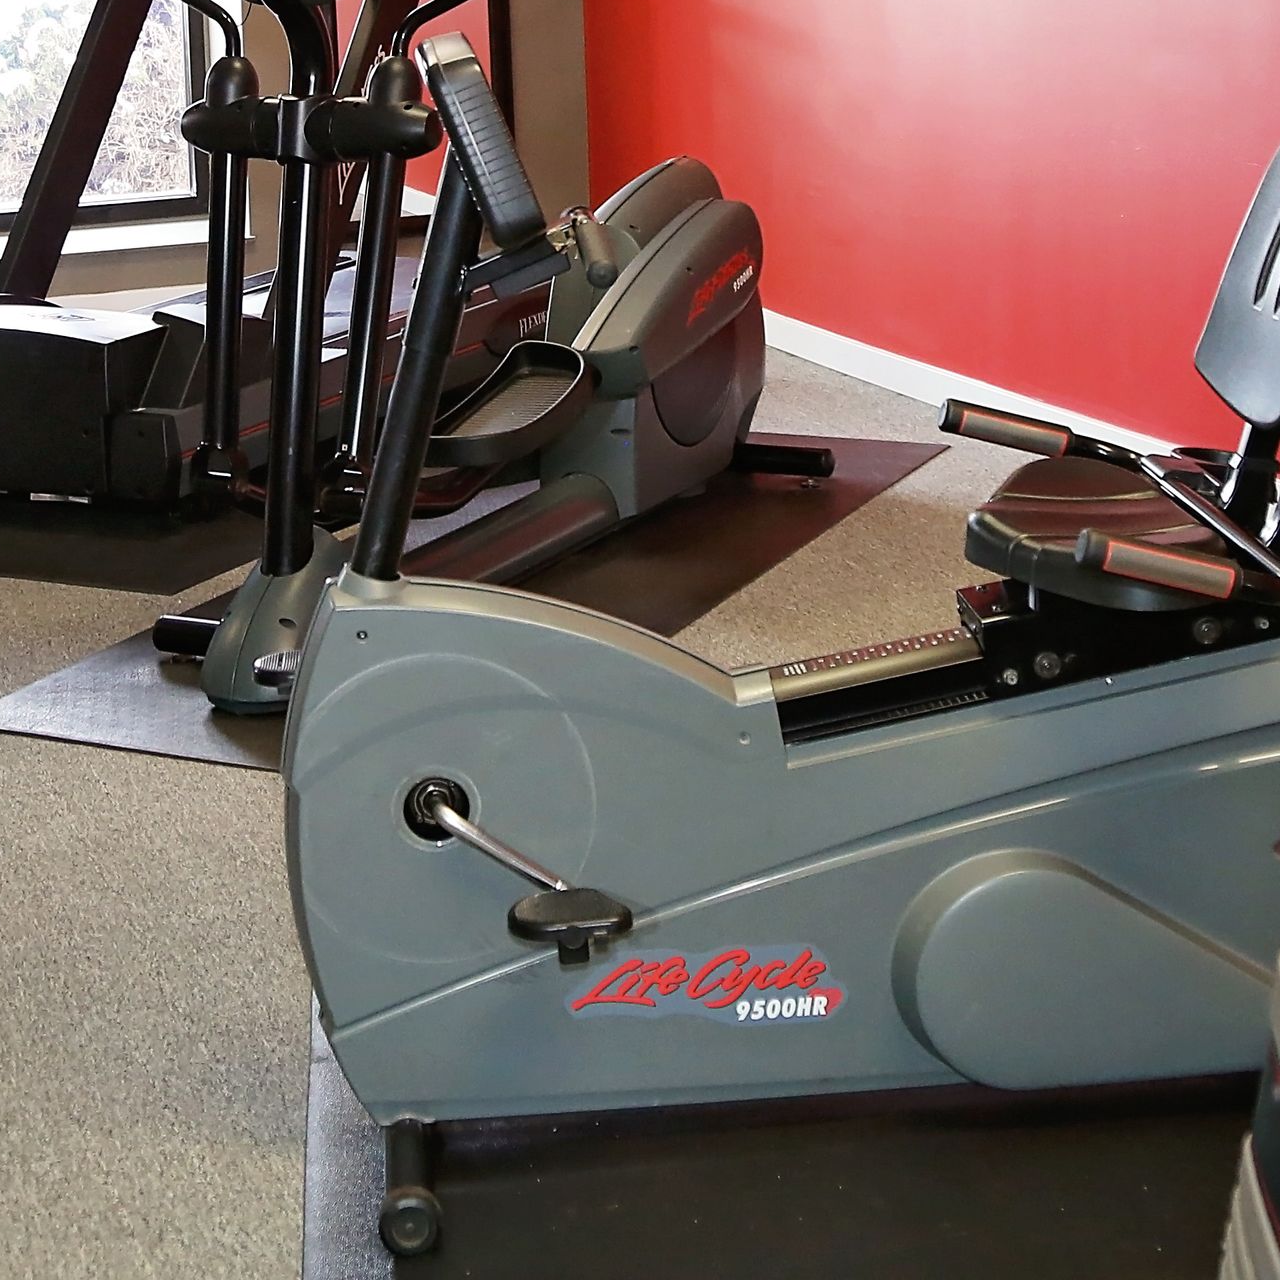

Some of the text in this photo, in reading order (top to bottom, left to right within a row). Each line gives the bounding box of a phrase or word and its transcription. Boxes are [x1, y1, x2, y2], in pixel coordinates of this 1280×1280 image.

[572, 948, 827, 1011] Life Cycle
[736, 995, 829, 1022] 9500HR
